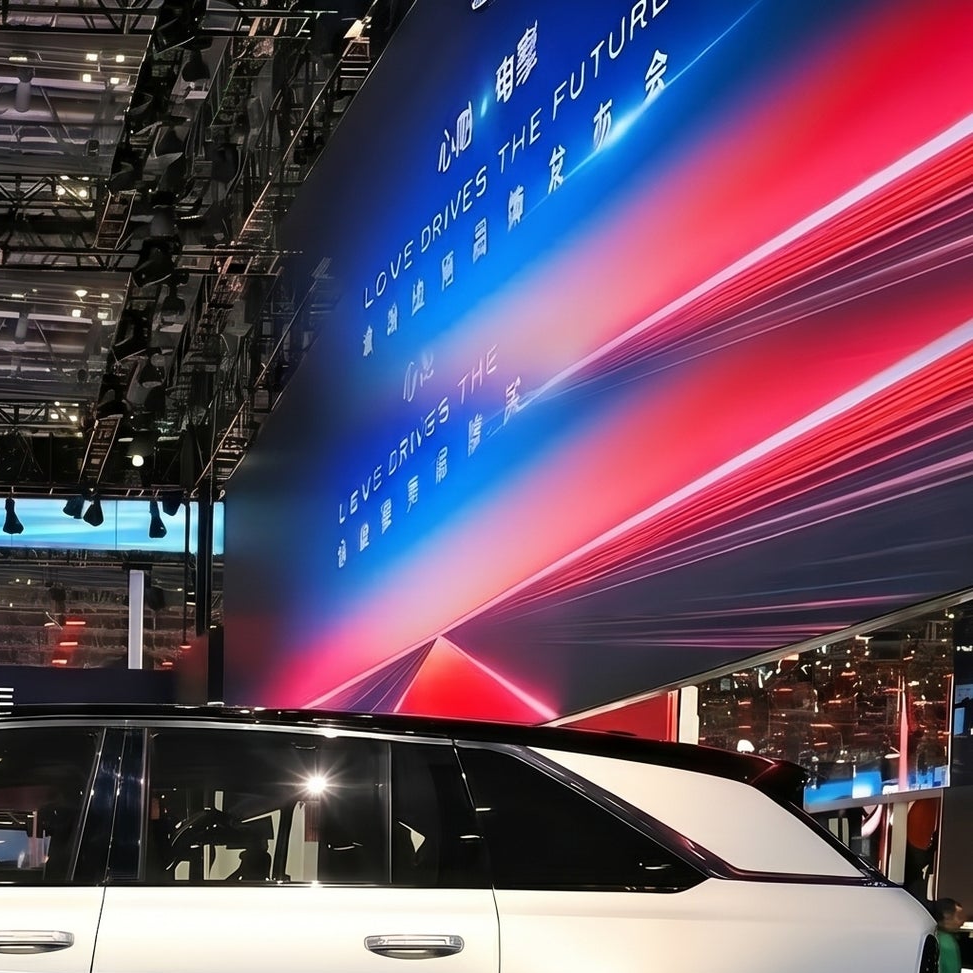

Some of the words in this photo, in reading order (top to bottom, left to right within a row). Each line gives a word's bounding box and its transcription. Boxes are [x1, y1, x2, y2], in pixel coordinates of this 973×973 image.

[363, 239, 415, 309] LOVE
[420, 165, 488, 254] DRIVES
[497, 107, 543, 174] THE
[388, 396, 450, 476] DRIVES
[457, 344, 498, 405] THE
